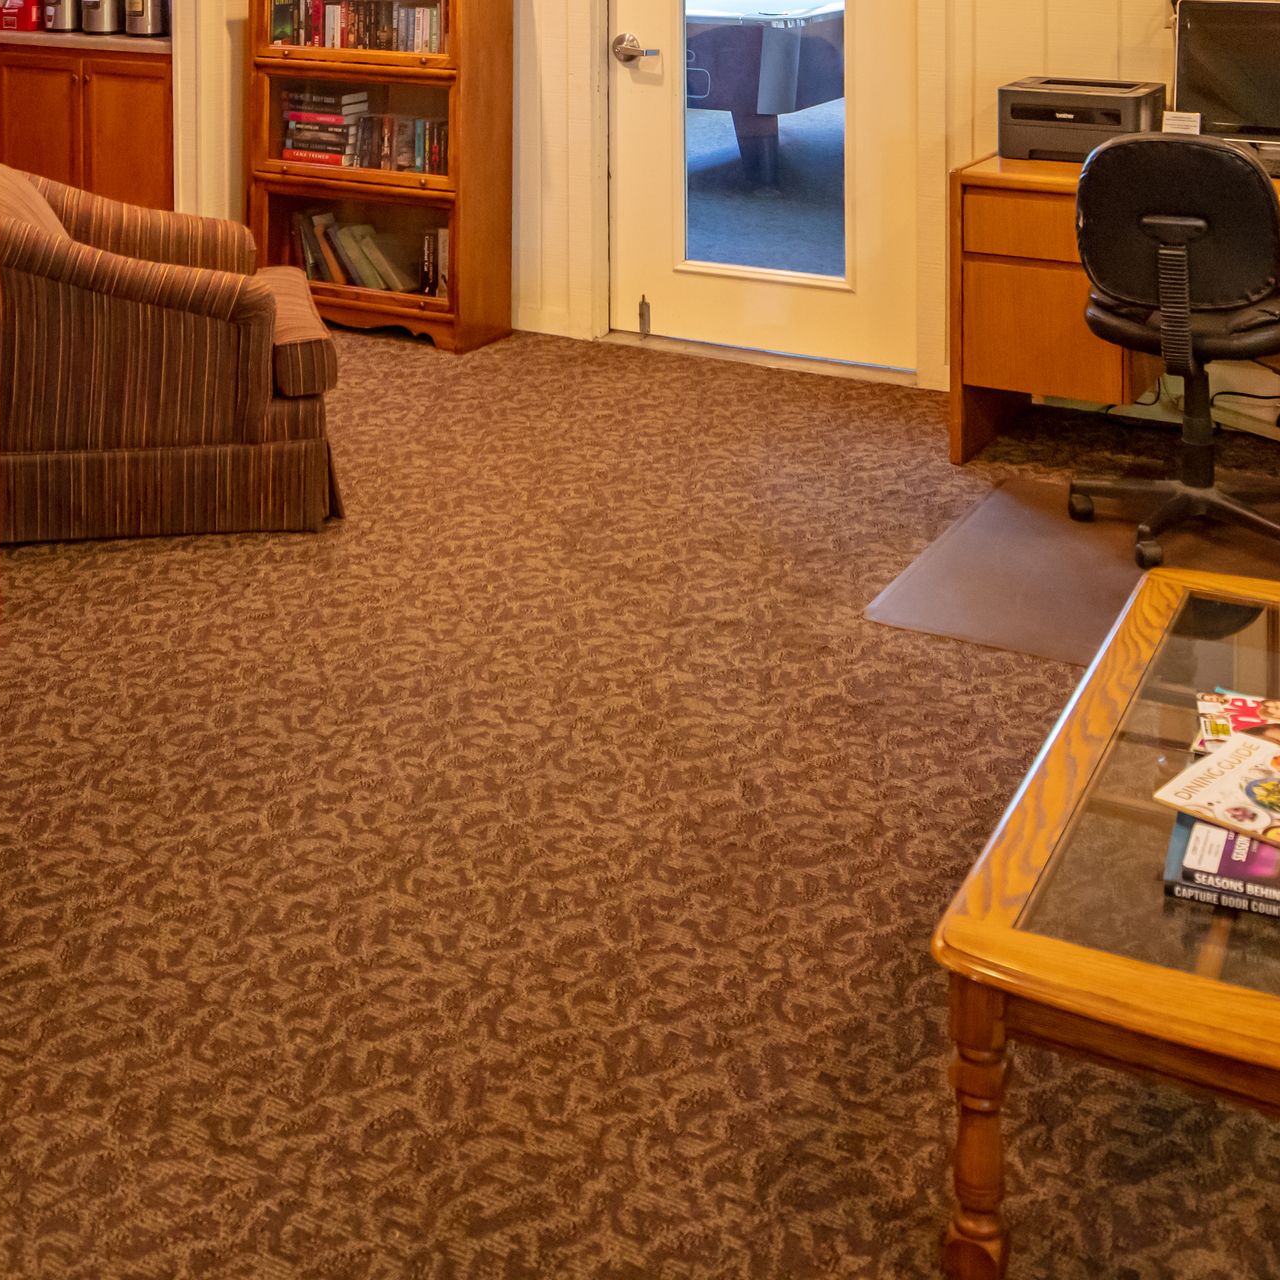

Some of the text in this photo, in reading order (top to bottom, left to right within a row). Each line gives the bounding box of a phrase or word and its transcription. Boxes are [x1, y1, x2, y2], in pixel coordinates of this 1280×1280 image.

[1173, 741, 1260, 801] DINING GUIDE
[1193, 873, 1244, 893] SEASONS
[1173, 886, 1219, 905] CAPTURE
[1220, 895, 1249, 911] DOOR
